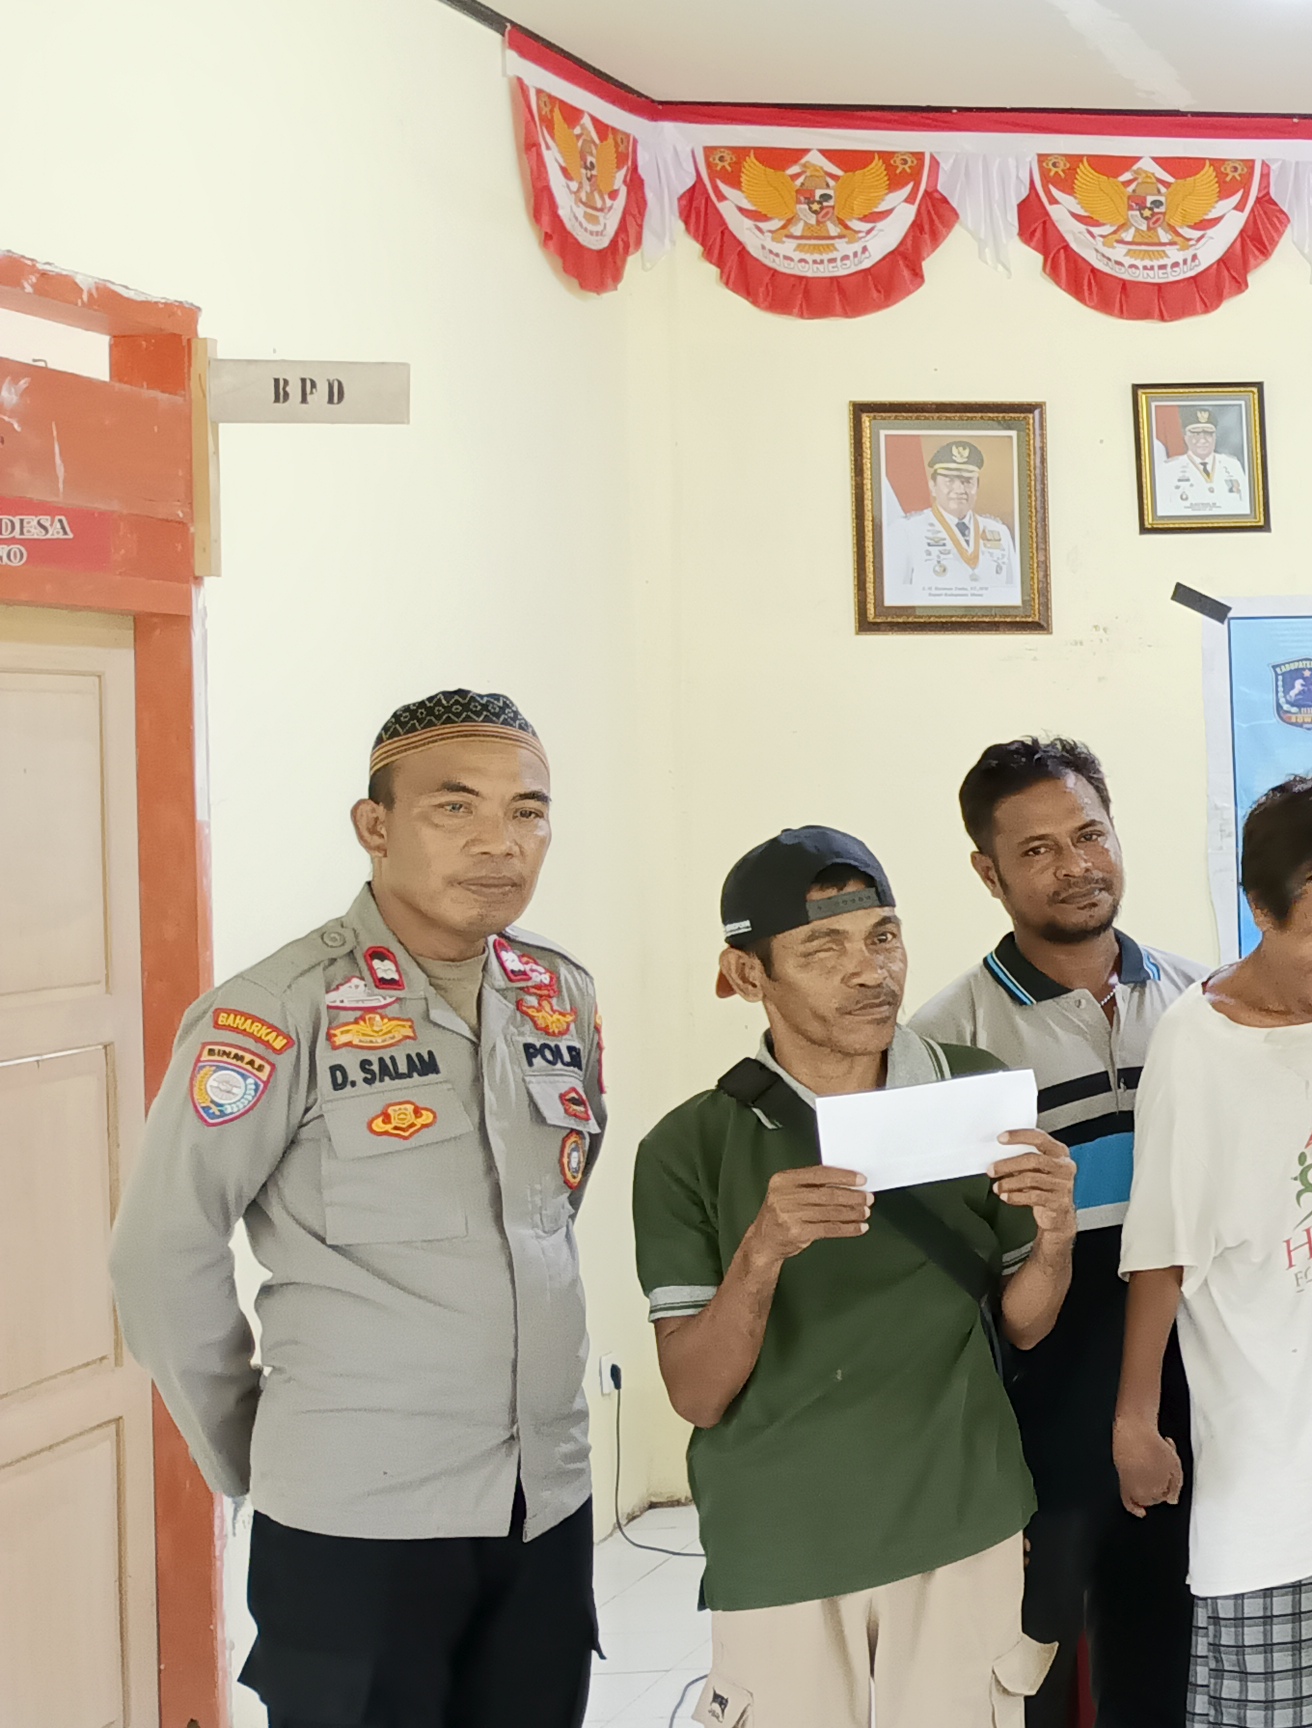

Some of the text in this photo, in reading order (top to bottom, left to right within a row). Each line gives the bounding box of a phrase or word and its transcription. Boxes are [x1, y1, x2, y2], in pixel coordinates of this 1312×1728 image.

[759, 243, 872, 275] INDONESIA
[1094, 248, 1201, 282] INDONESIA
[272, 377, 346, 405] BPD
[206, 1048, 266, 1073] BINMAS
[328, 1050, 441, 1092] D. SALAM
